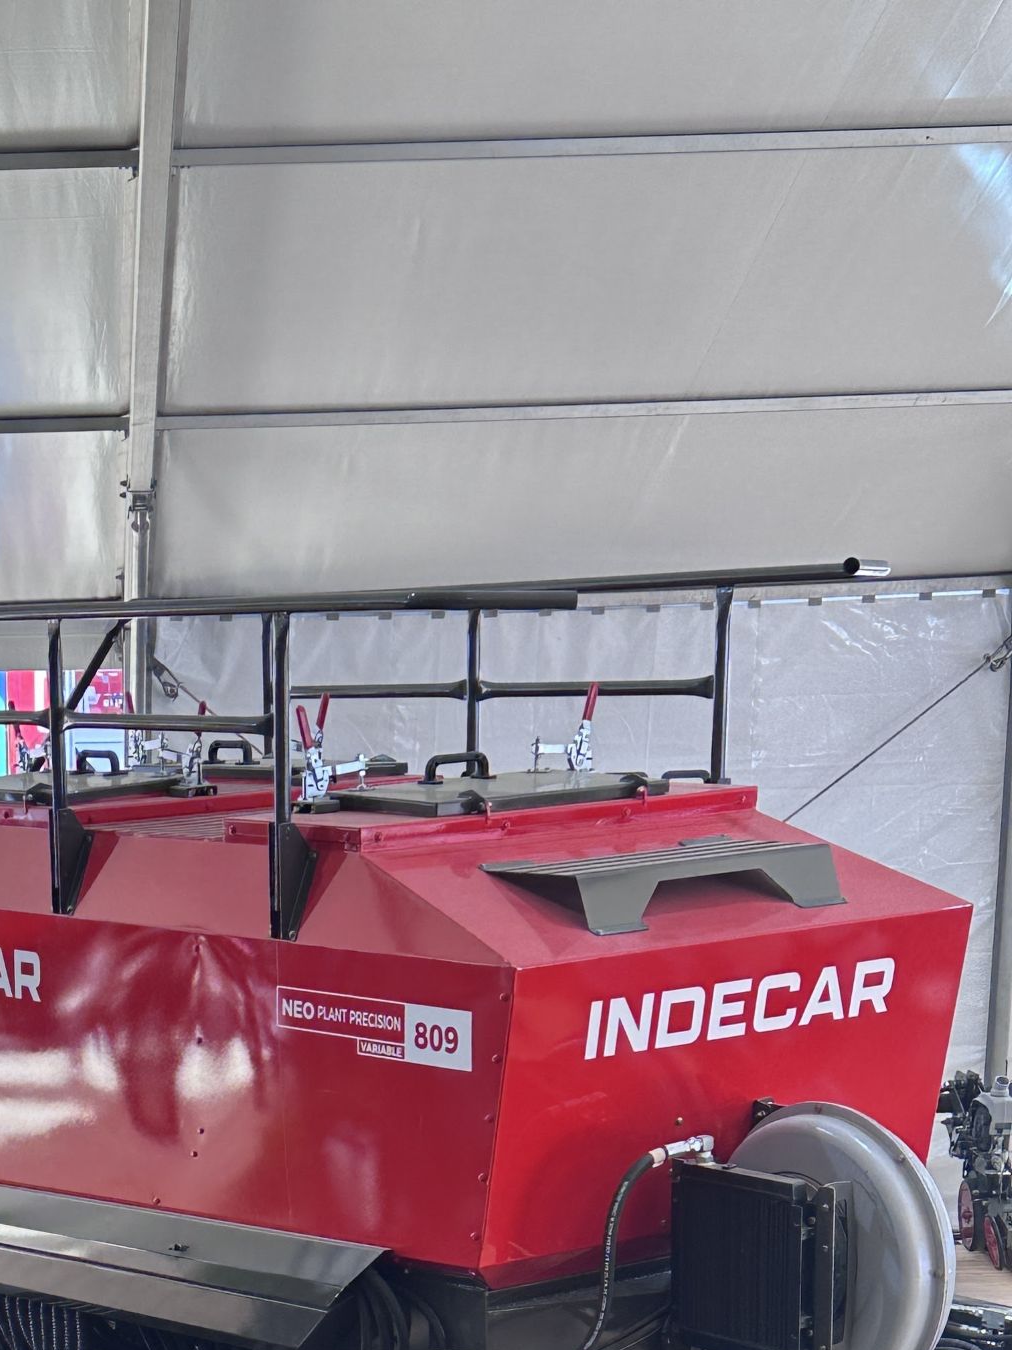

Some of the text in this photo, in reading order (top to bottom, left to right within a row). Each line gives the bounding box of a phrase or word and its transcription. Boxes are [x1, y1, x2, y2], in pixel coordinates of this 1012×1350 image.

[281, 998, 401, 1032] NEO PLANT PRECISION
[584, 957, 896, 1060] INDECAR
[360, 1041, 403, 1058] VARIABLE
[414, 1022, 459, 1054] 809
